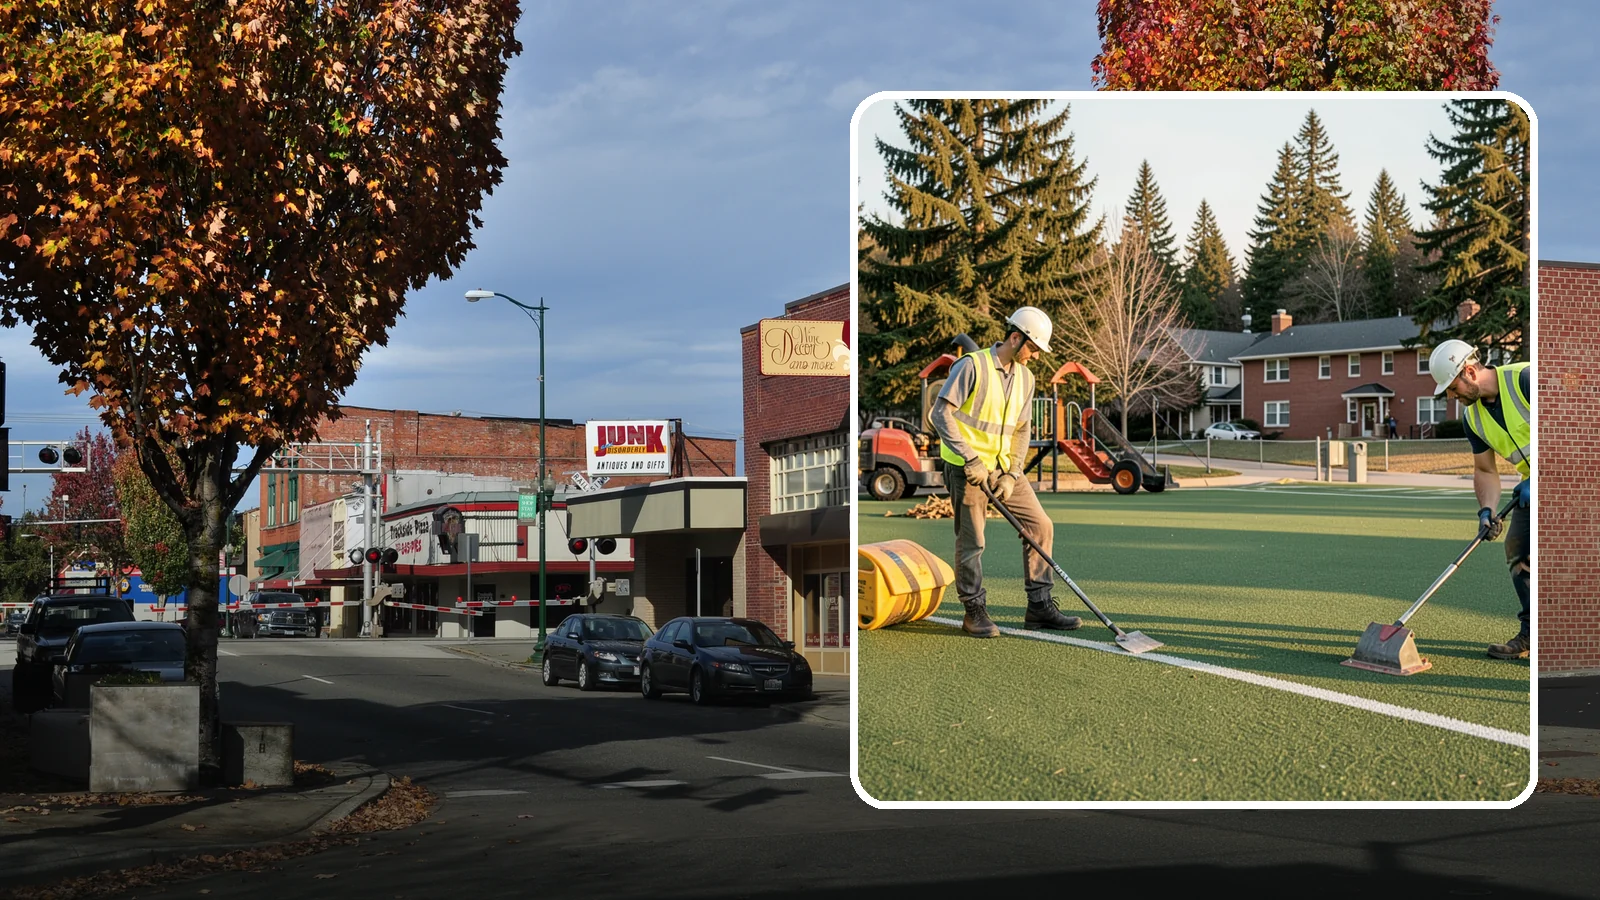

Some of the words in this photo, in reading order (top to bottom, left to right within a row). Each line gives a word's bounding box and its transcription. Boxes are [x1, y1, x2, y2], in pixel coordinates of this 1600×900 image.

[595, 425, 665, 457] JUNK
[607, 446, 646, 454] DISORDERLY
[597, 461, 628, 470] ANTIQUES
[631, 461, 644, 470] AND
[646, 461, 665, 470] GIFTS
[414, 520, 429, 535] Pizza
